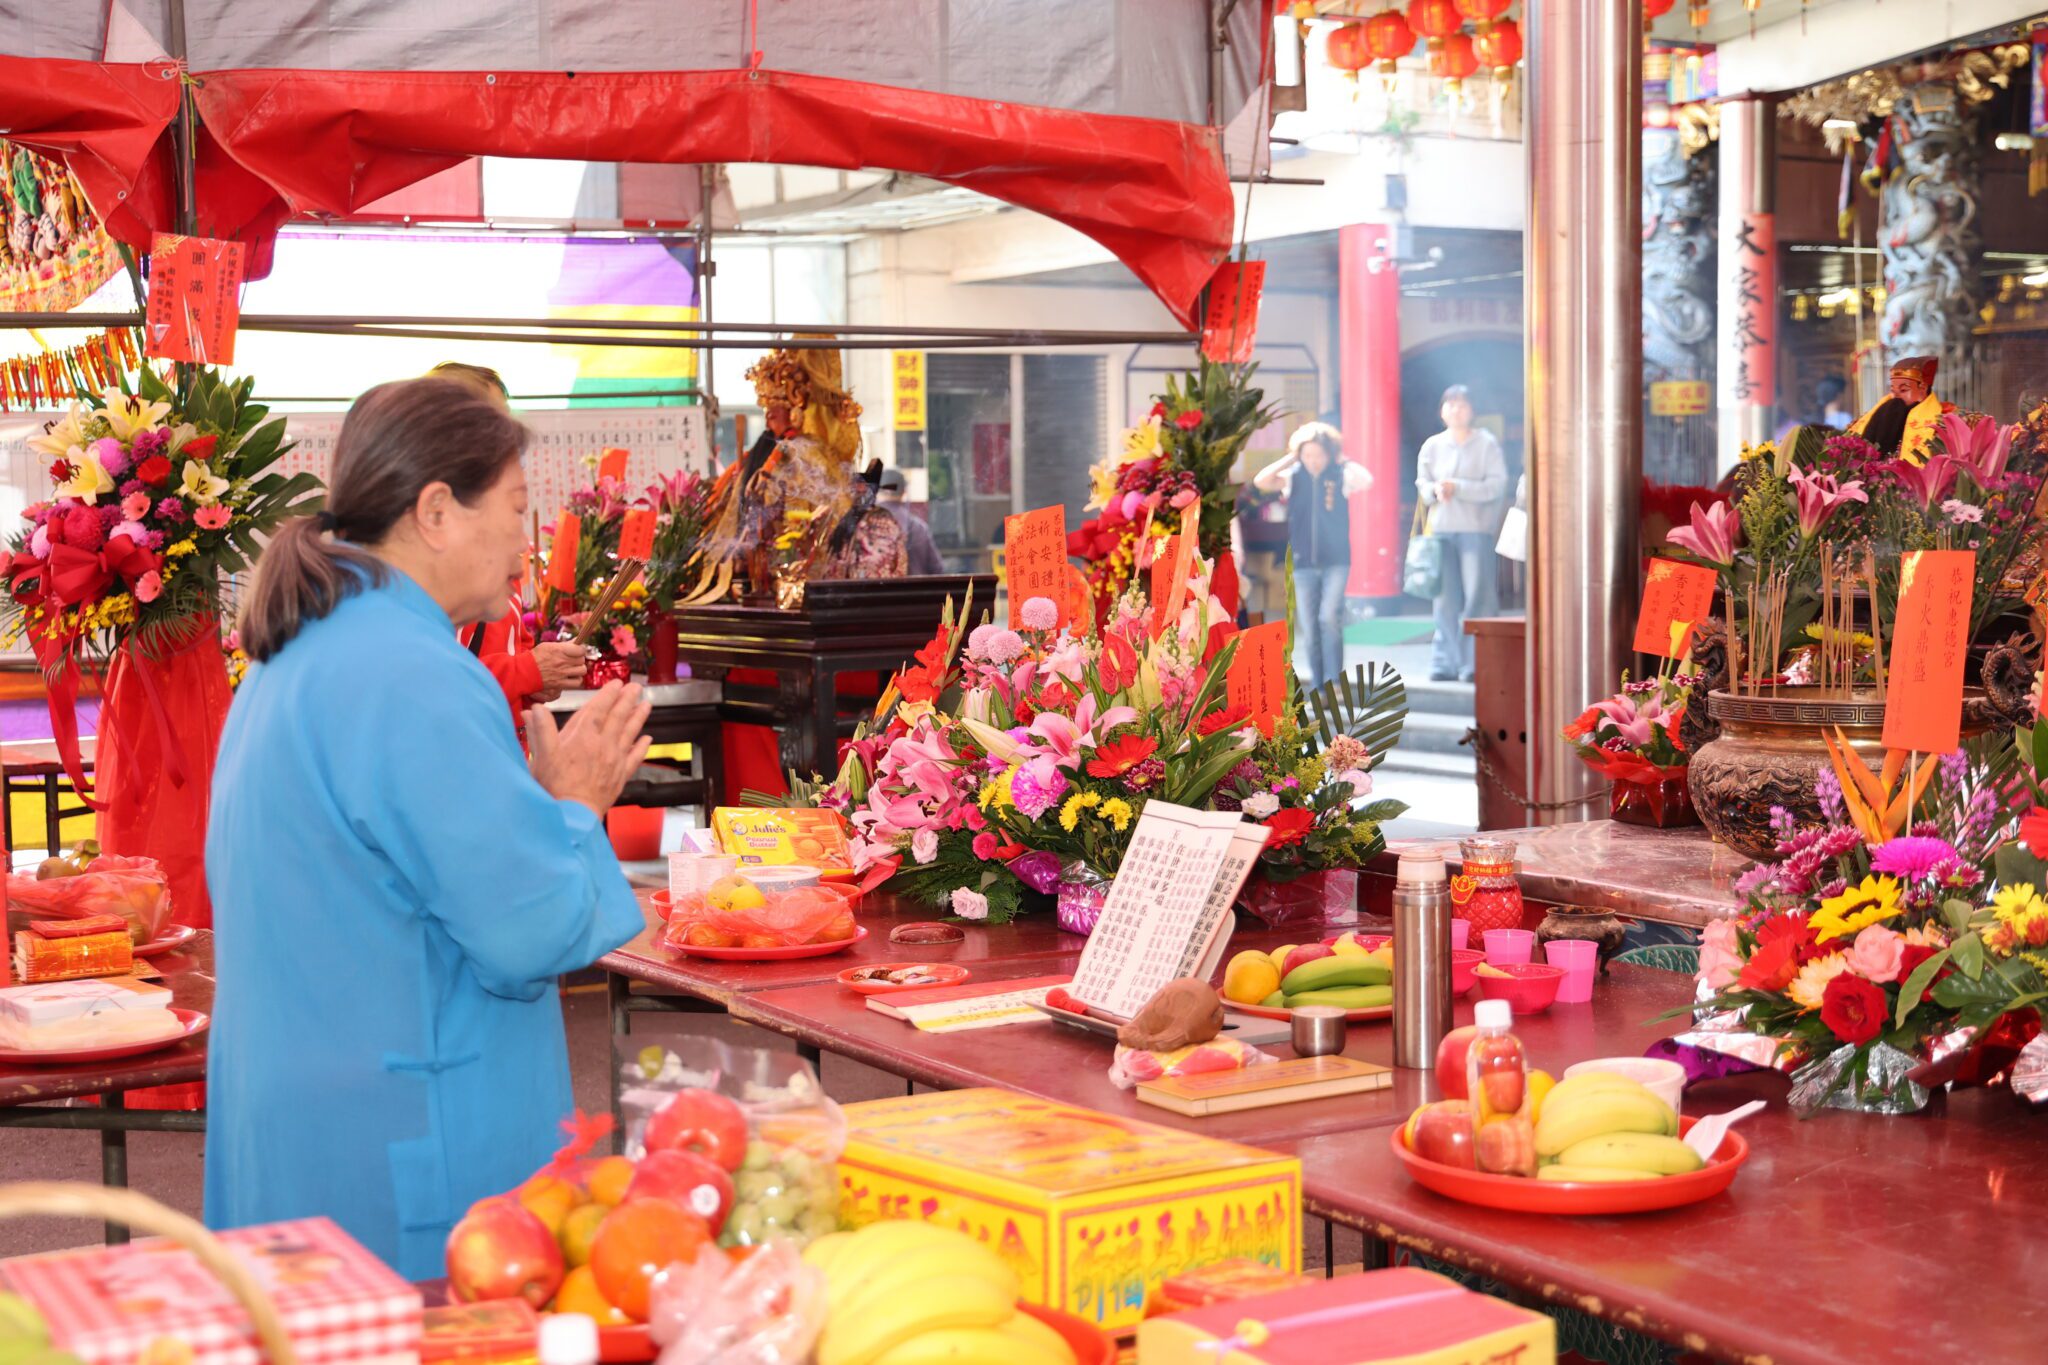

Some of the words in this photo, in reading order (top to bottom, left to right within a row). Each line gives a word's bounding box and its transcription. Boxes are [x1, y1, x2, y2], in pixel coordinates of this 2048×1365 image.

[1039, 520, 1053, 600] 祈安禮
[1912, 574, 1935, 683] 香火鼎盛
[751, 825, 787, 833] Julie's
